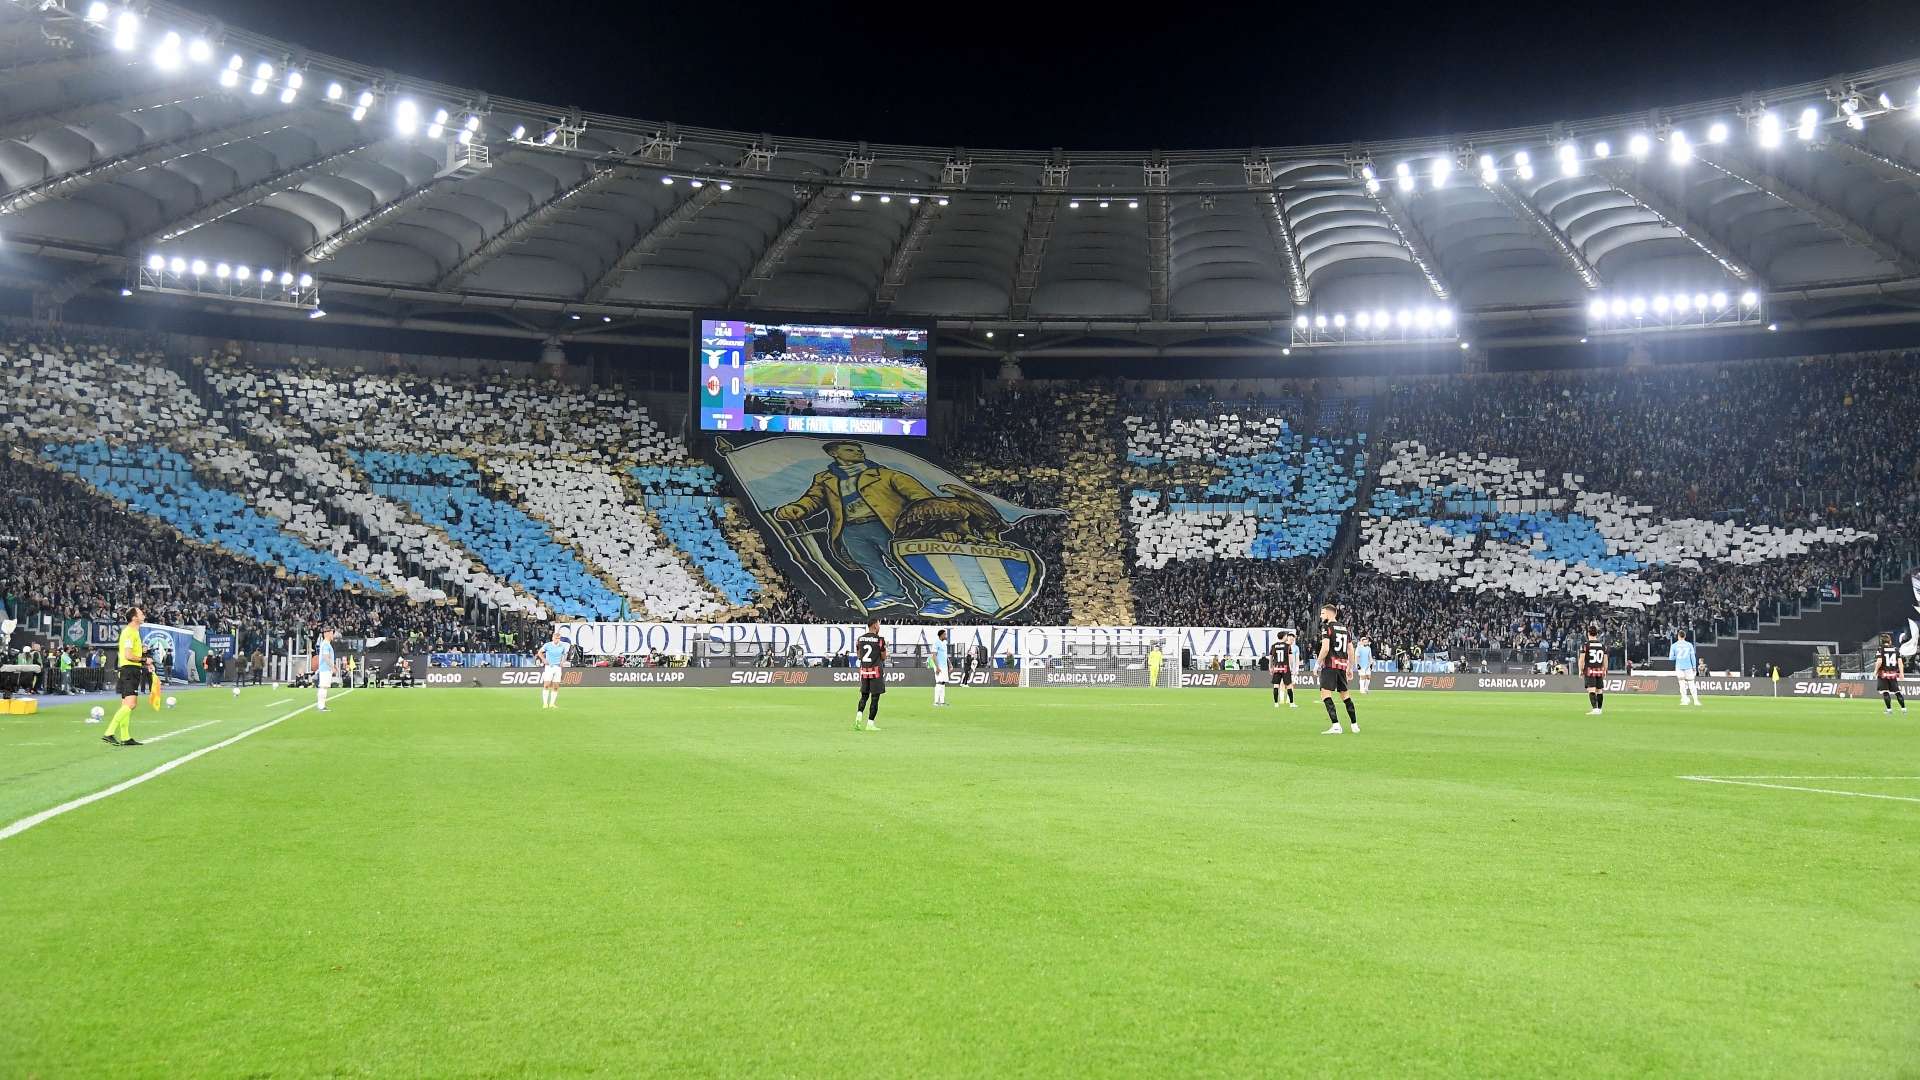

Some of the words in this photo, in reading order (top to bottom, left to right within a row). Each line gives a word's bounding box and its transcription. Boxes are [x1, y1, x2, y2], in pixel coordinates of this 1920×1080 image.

[732, 351, 740, 368] 0
[732, 377, 740, 395] 0
[904, 543, 965, 554] CURVA
[970, 545, 1021, 559] NORD
[709, 625, 812, 655] SPADA
[825, 626, 936, 655] DELA
[1334, 633, 1347, 653] 31
[862, 644, 873, 662] 2
[1276, 650, 1284, 662] 11
[1589, 649, 1604, 664] 30
[1884, 653, 1897, 666] 14
[427, 673, 461, 683] 00:00
[609, 672, 654, 682] SCARICA
[657, 672, 685, 682] L'APP
[1047, 673, 1088, 683] SCARICA
[1090, 673, 1116, 683] L'APP
[1478, 678, 1519, 688] SCARICA
[1520, 679, 1546, 688] L'APP
[1724, 681, 1751, 691] L'APP
